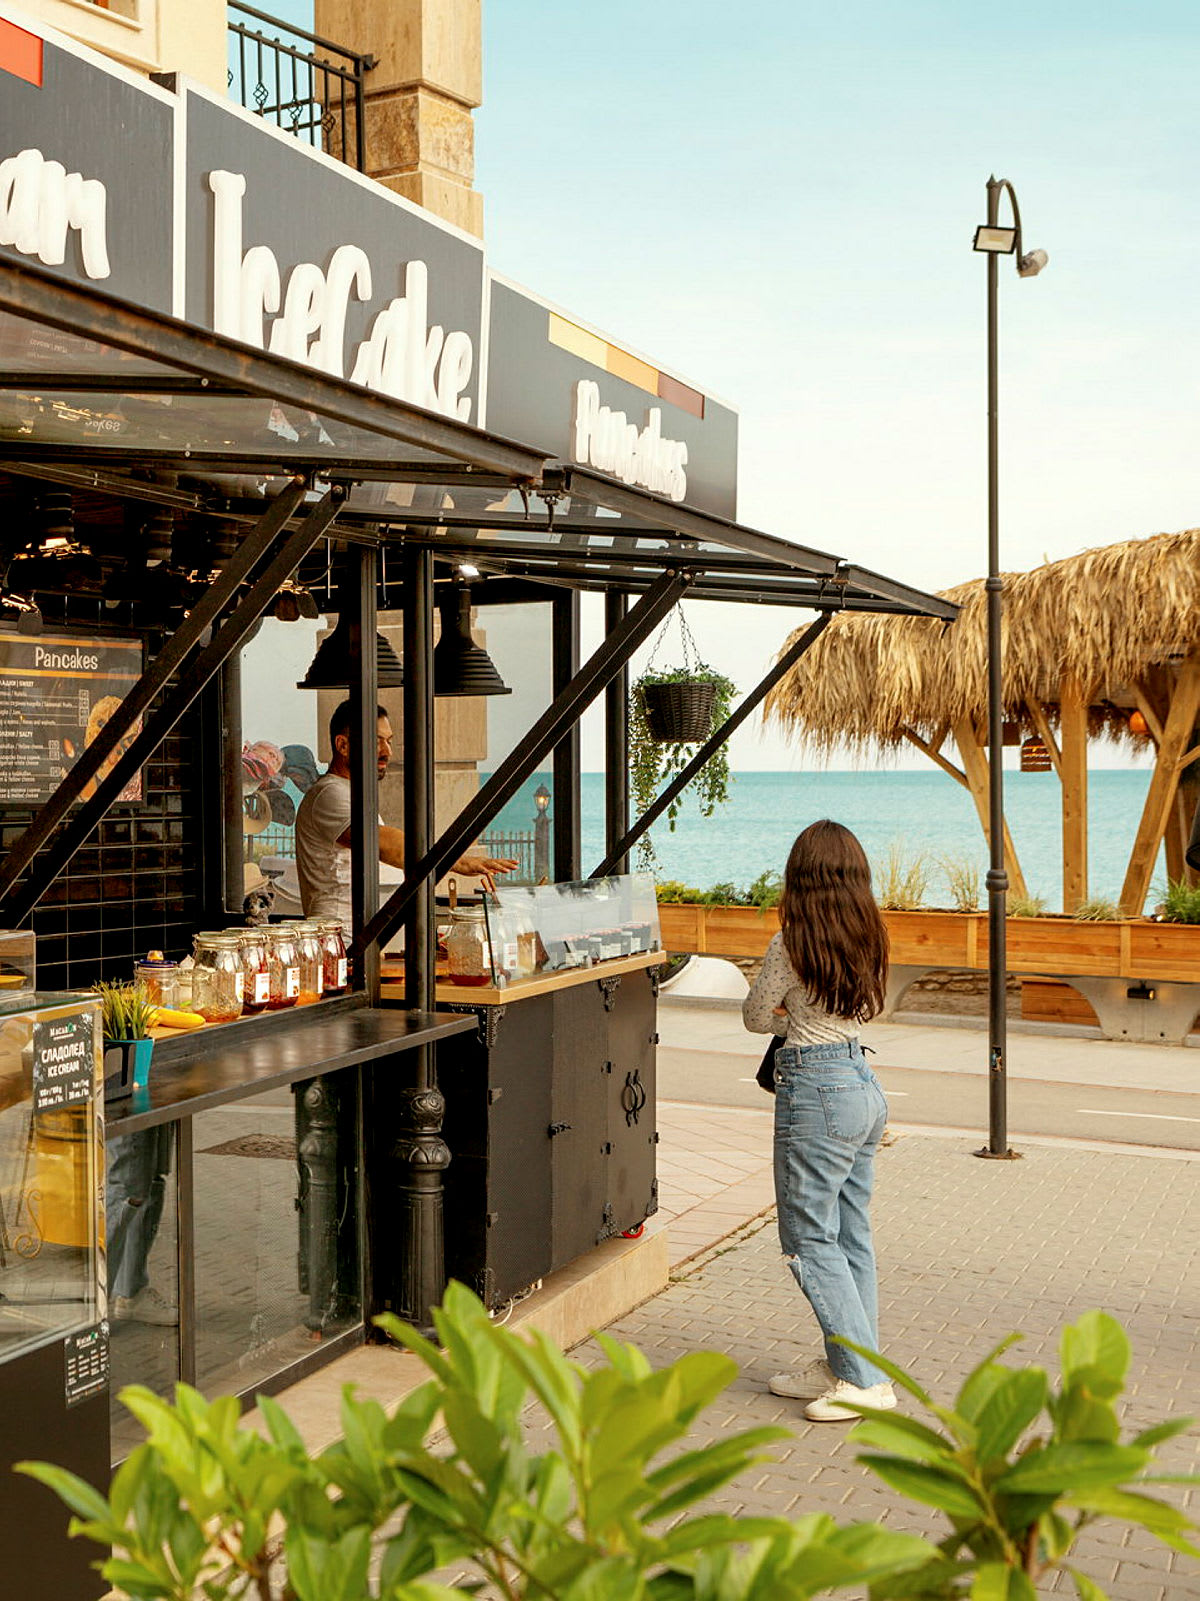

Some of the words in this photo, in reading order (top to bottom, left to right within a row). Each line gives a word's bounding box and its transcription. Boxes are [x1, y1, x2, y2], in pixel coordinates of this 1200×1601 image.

[35, 646, 98, 670] Pancakes
[41, 1041, 85, 1063] СЛАДОЛЕД
[47, 1065, 57, 1078] ICE
[58, 1060, 79, 1074] CREAM
